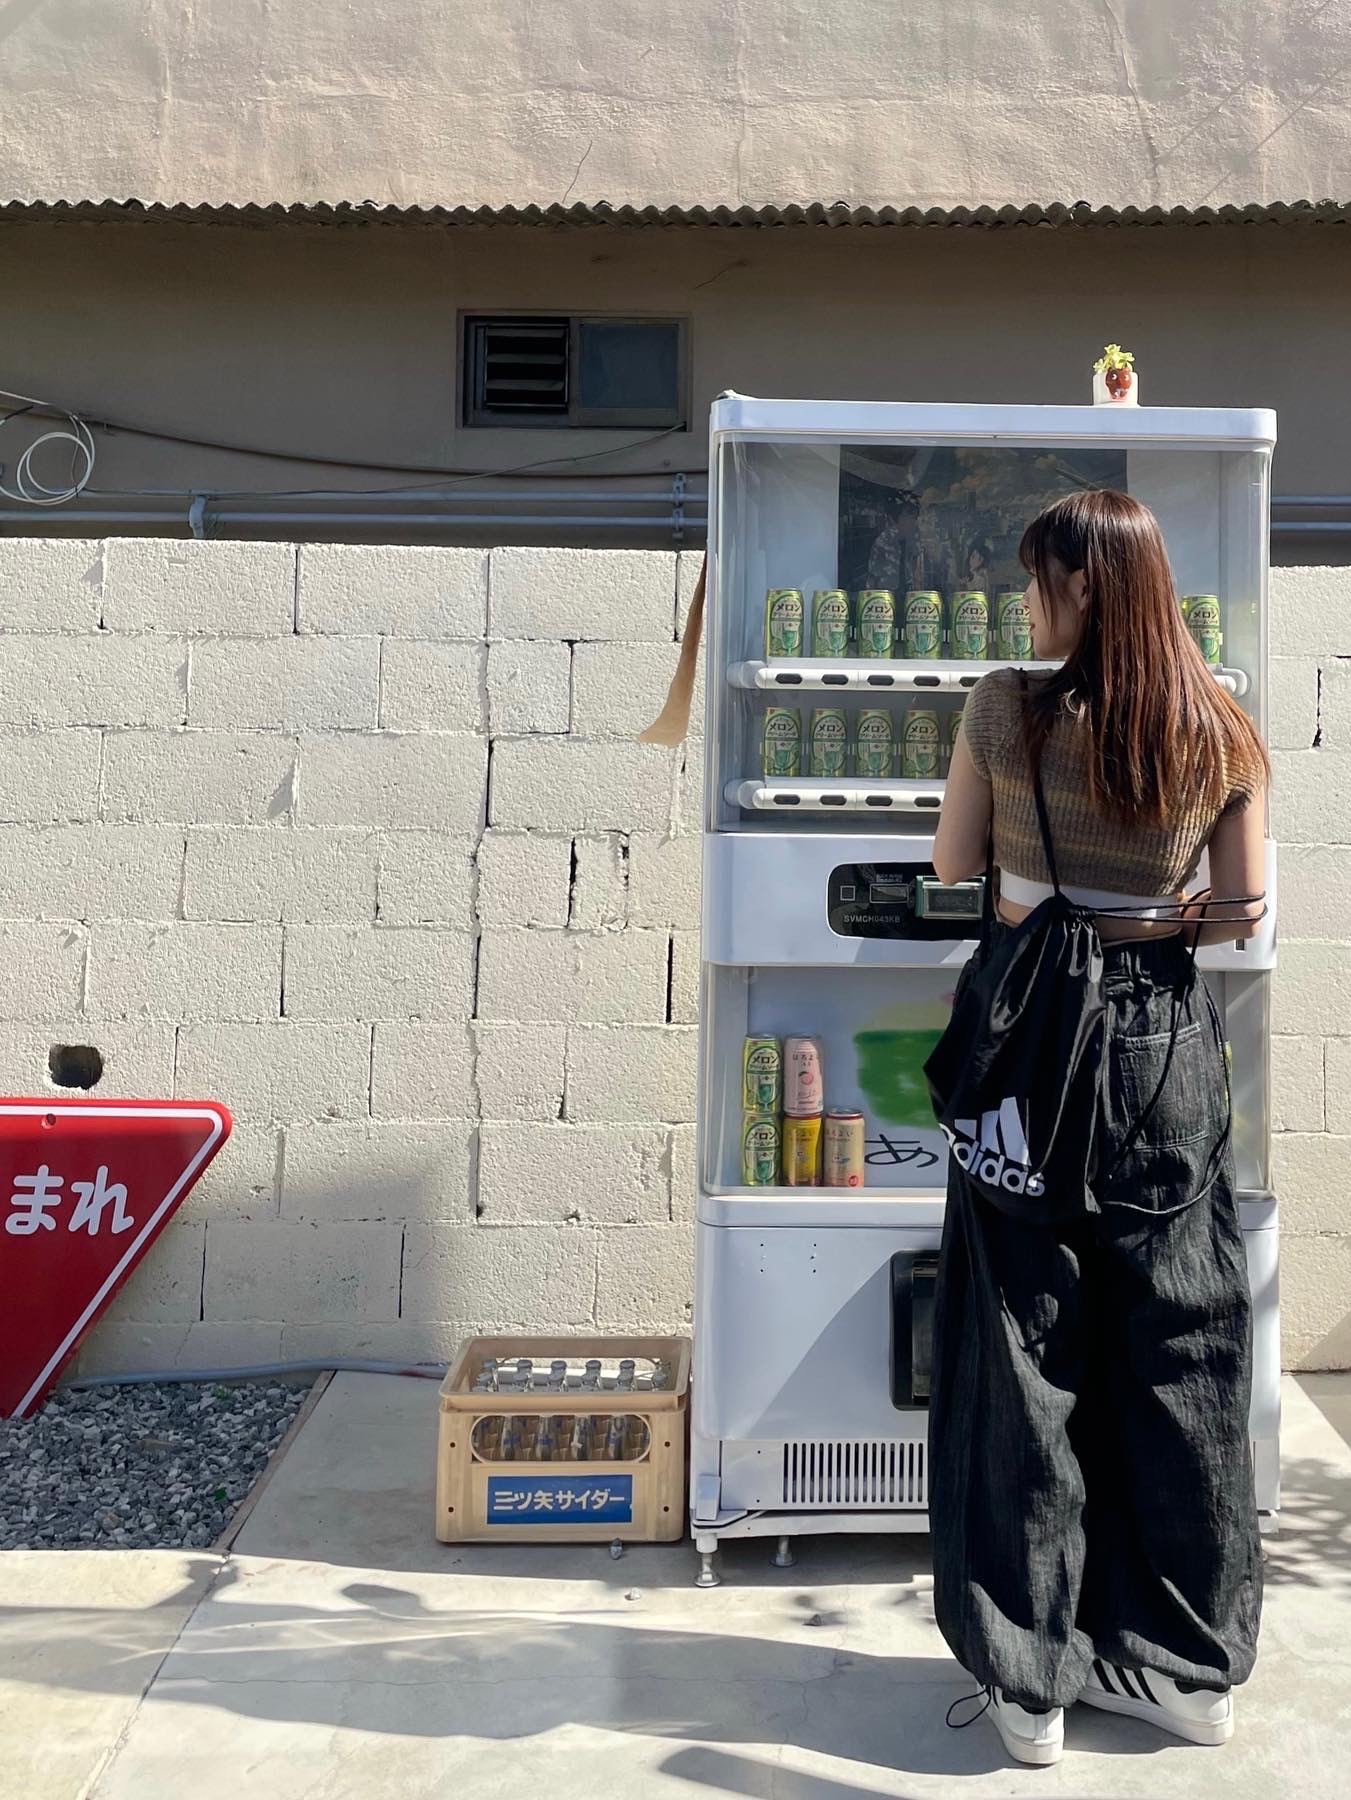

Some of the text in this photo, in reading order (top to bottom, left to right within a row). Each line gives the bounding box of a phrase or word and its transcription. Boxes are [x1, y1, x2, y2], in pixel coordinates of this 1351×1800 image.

[777, 604, 800, 612] メロン
[823, 605, 848, 613] メロン
[866, 606, 891, 614] メロン
[910, 606, 936, 614] メロン
[961, 607, 985, 615] メロン
[1006, 607, 1031, 616] メロン
[1193, 611, 1217, 619] メロン
[769, 723, 795, 731] メロン
[819, 724, 844, 732] メロン
[863, 725, 888, 733] メロン
[911, 725, 937, 734] メロン
[752, 1055, 778, 1064] メロン
[751, 1131, 776, 1140] メロン
[493, 1488, 625, 1511] 三ツ矢サイダー
